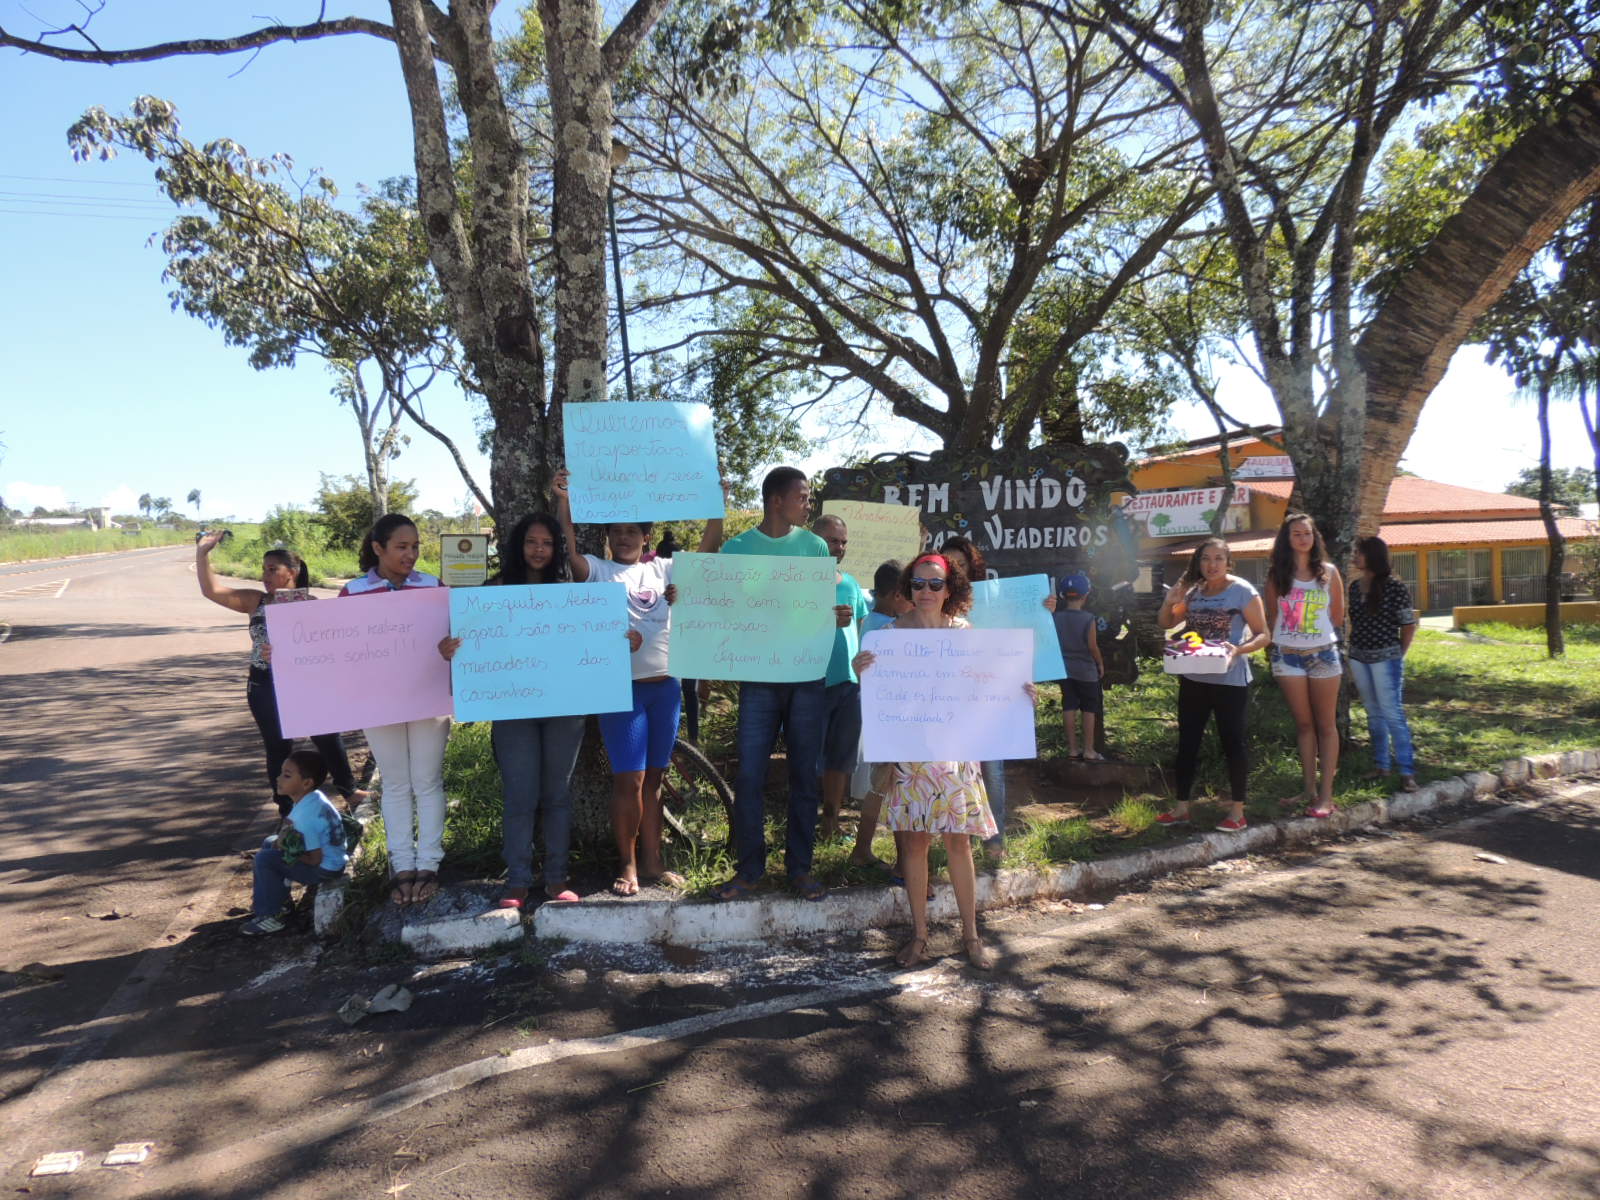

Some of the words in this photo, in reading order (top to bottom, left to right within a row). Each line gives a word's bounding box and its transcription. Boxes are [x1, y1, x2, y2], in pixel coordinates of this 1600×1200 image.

[980, 475, 1087, 511] VINDO
[1209, 490, 1216, 503] E
[292, 621, 360, 644] Queremos
[1180, 631, 1204, 648] 3
[294, 654, 336, 666] nossos
